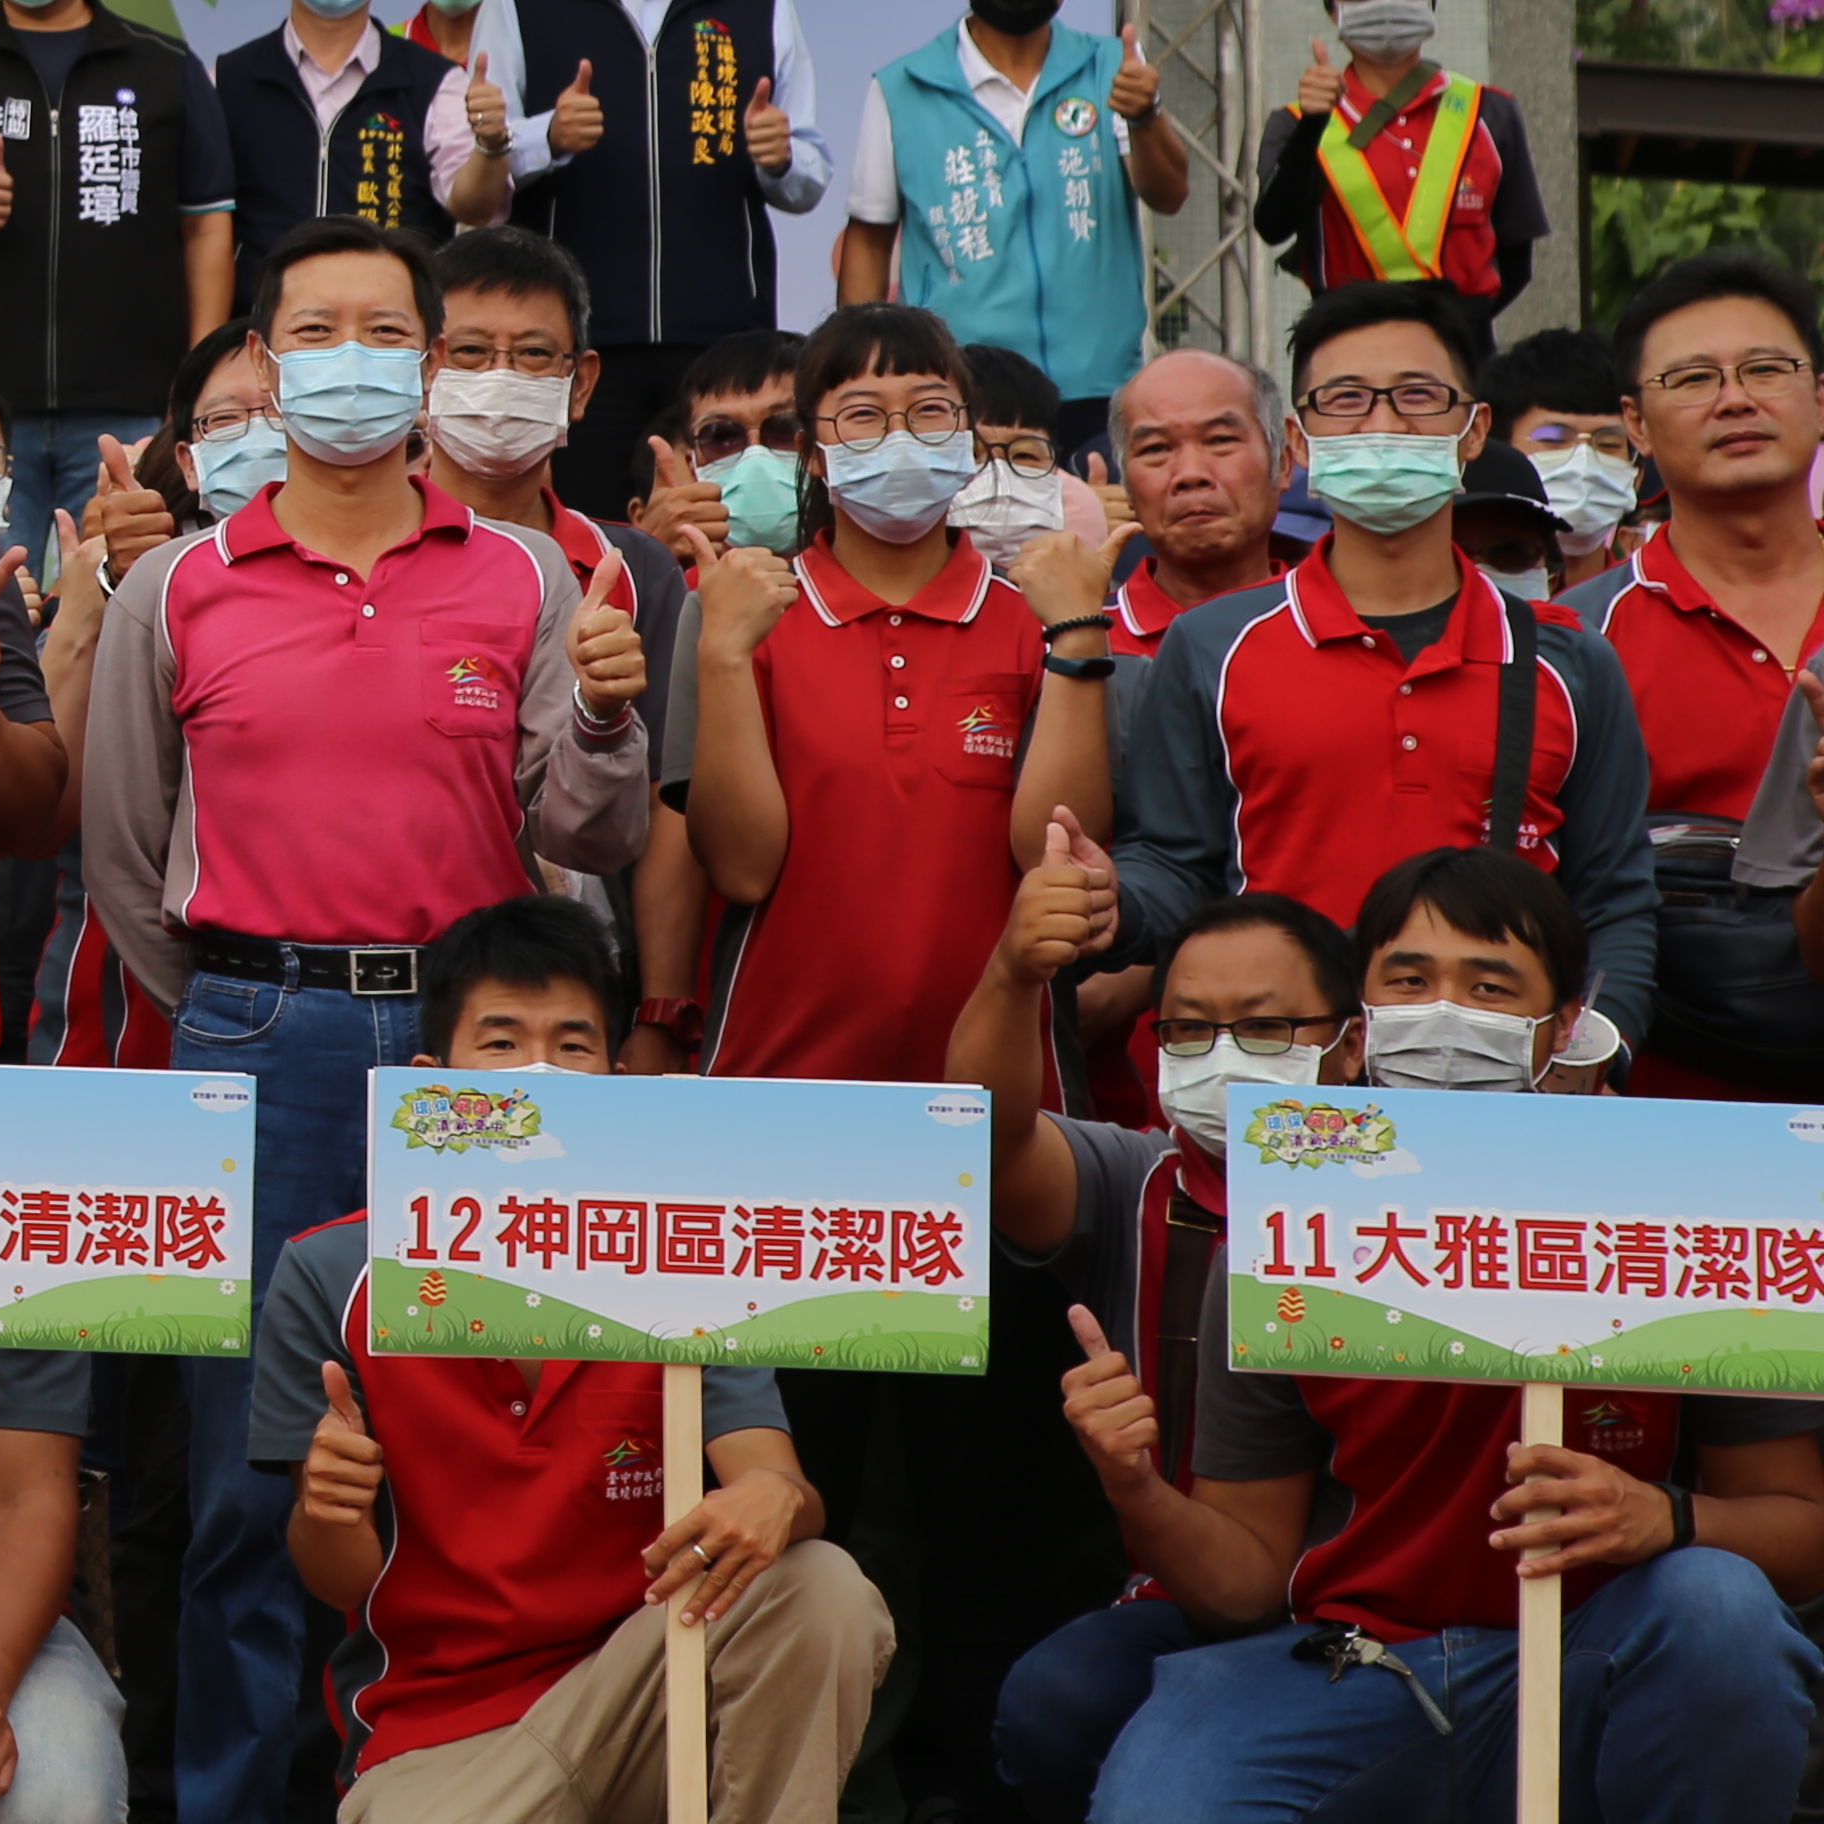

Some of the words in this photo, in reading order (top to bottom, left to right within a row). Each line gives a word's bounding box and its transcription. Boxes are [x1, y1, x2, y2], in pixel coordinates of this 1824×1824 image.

[78, 105, 121, 225] 羅廷瑋
[945, 145, 995, 262] 莊競程
[407, 1195, 964, 1286] 12神岡區清潔隊
[1263, 1210, 1824, 1303] 11大雅區清潔隊
